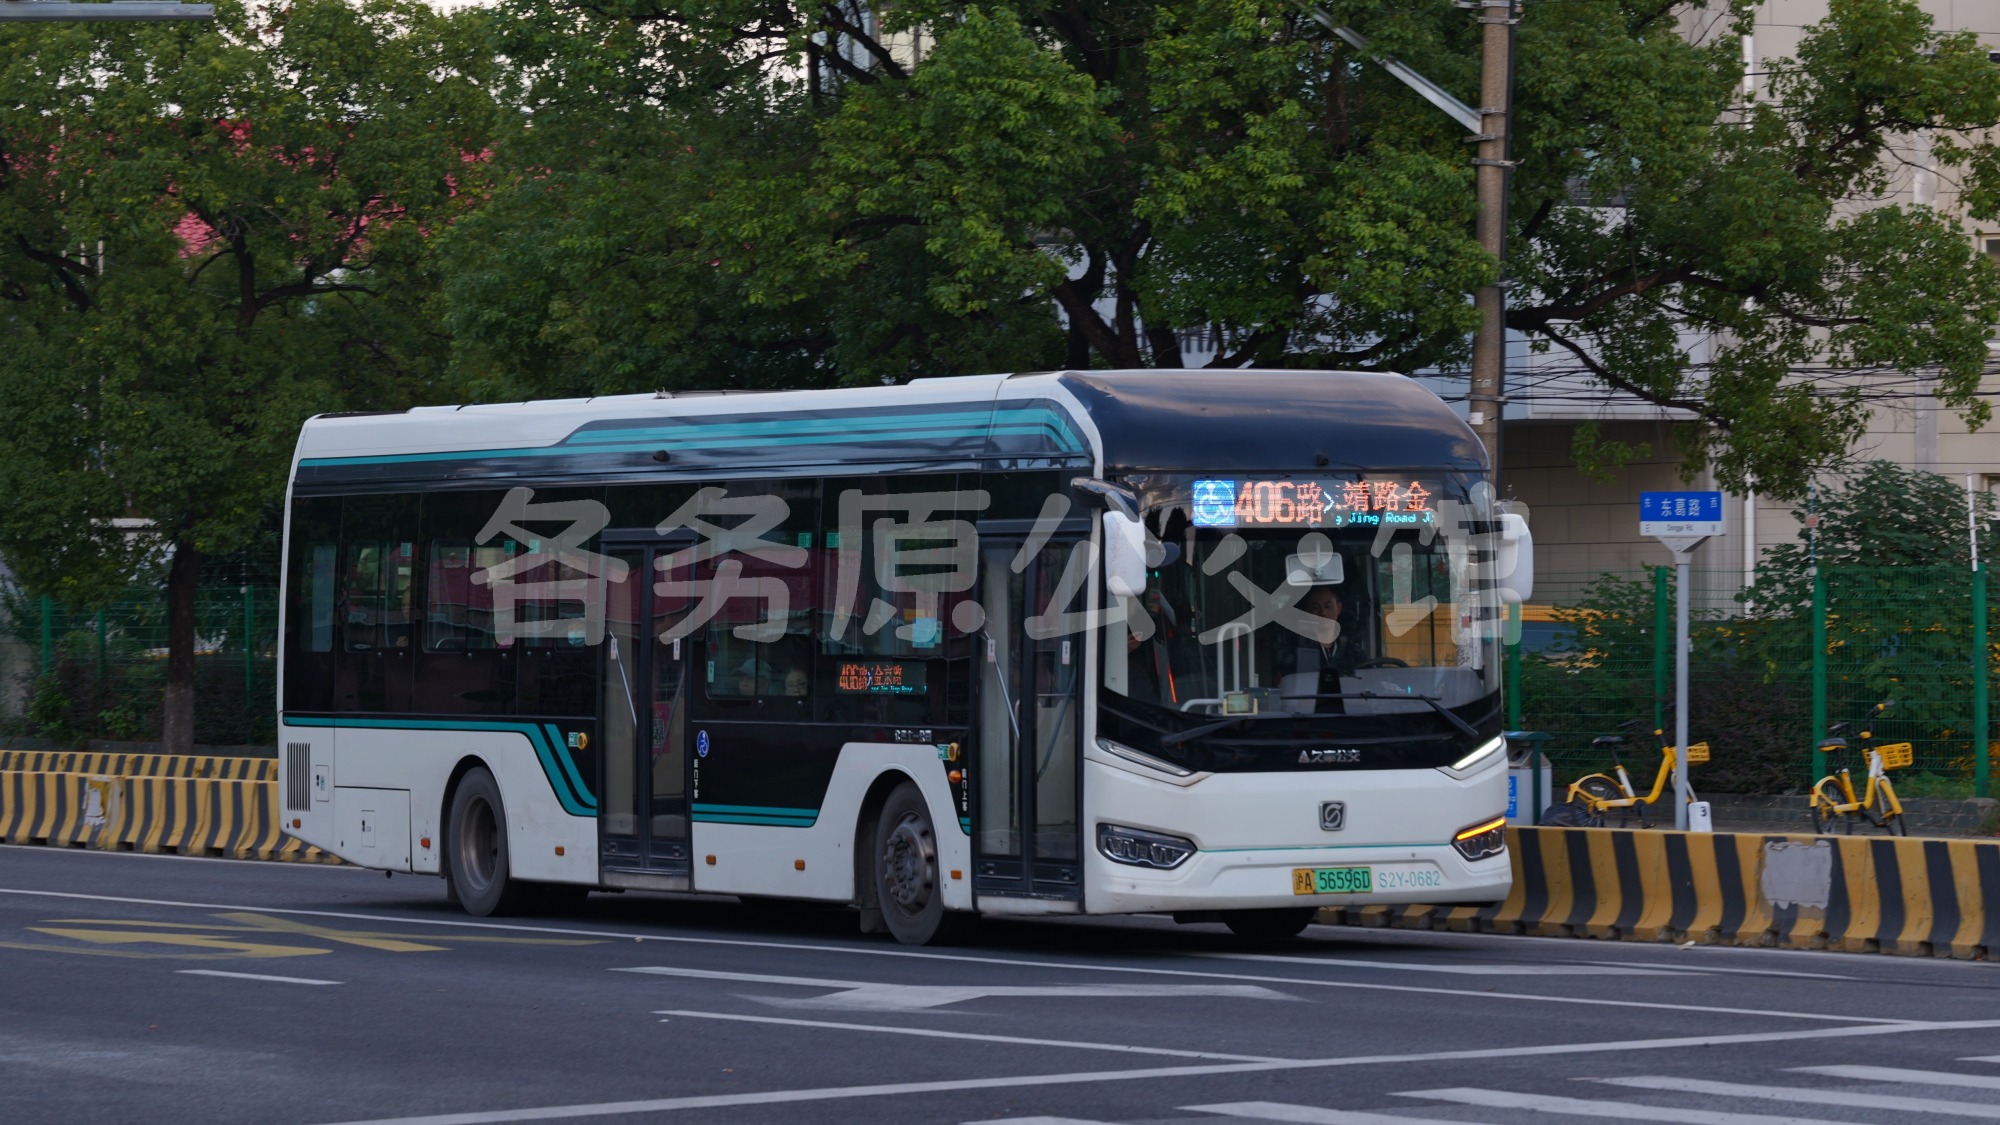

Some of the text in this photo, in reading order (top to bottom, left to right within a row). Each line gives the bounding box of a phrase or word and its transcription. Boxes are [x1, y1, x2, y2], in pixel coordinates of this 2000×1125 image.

[1235, 480, 1434, 523] 406路 靖路金
[1348, 512, 1380, 525] Jing
[1385, 512, 1417, 523] Road
[1700, 806, 1707, 817] 3
[1378, 870, 1441, 888] S2Y-0682
